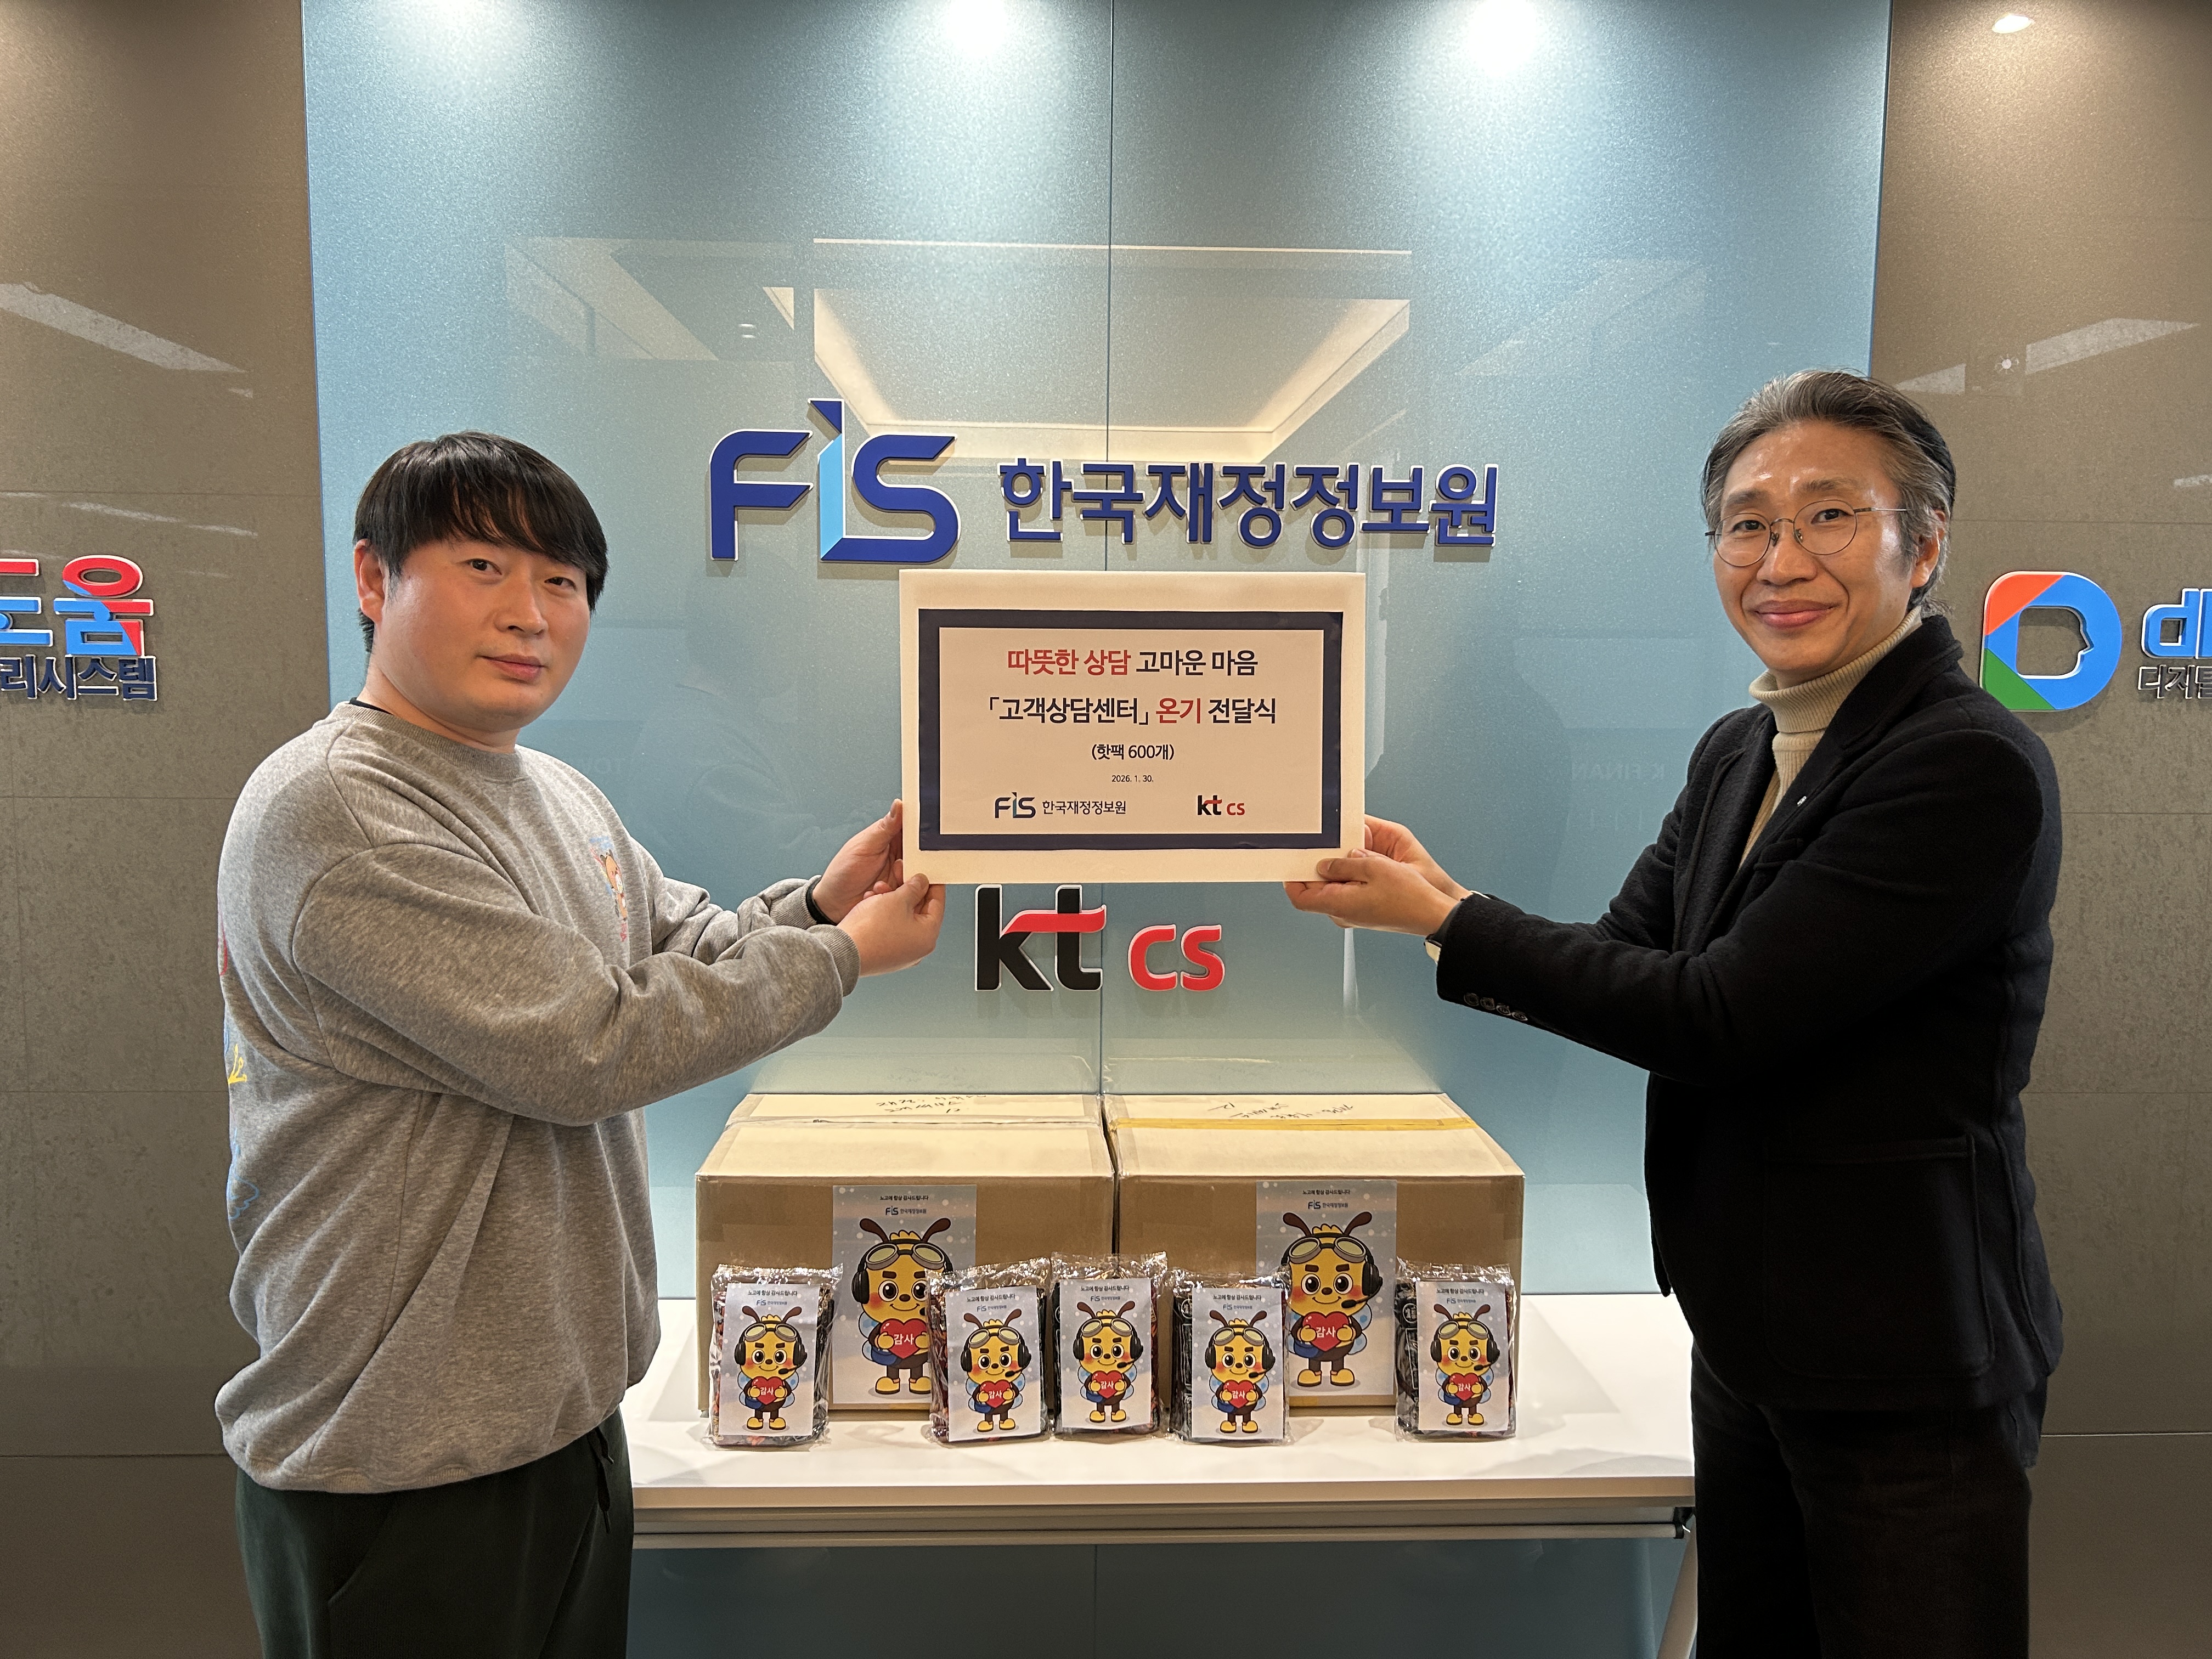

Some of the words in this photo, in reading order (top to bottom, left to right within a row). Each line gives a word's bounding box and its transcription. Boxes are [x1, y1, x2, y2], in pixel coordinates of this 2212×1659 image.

[997, 458, 1498, 548] 한국재정정보원
[1008, 648, 1079, 675] 따뜻한
[1084, 649, 1132, 676] 상담
[1136, 650, 1206, 676] 고마운
[1212, 650, 1258, 676] 마음
[0, 654, 157, 701] 리시스템
[1155, 697, 1201, 724] 온기
[1207, 698, 1276, 724] 전달식
[1091, 743, 1125, 760] (핫팩
[1128, 743, 1175, 760] 600개)
[1042, 800, 1126, 815] 한국재정정보원
[1197, 795, 1222, 816] kt
[975, 884, 1107, 991] kt
[893, 1334, 915, 1345] 감사
[1316, 1327, 1336, 1339] 감사
[760, 1386, 774, 1396] 감사
[1100, 1381, 1114, 1390] 감사
[1458, 1383, 1471, 1392] 감사
[989, 1390, 1003, 1400] 감사
[1232, 1390, 1246, 1400] 감사
